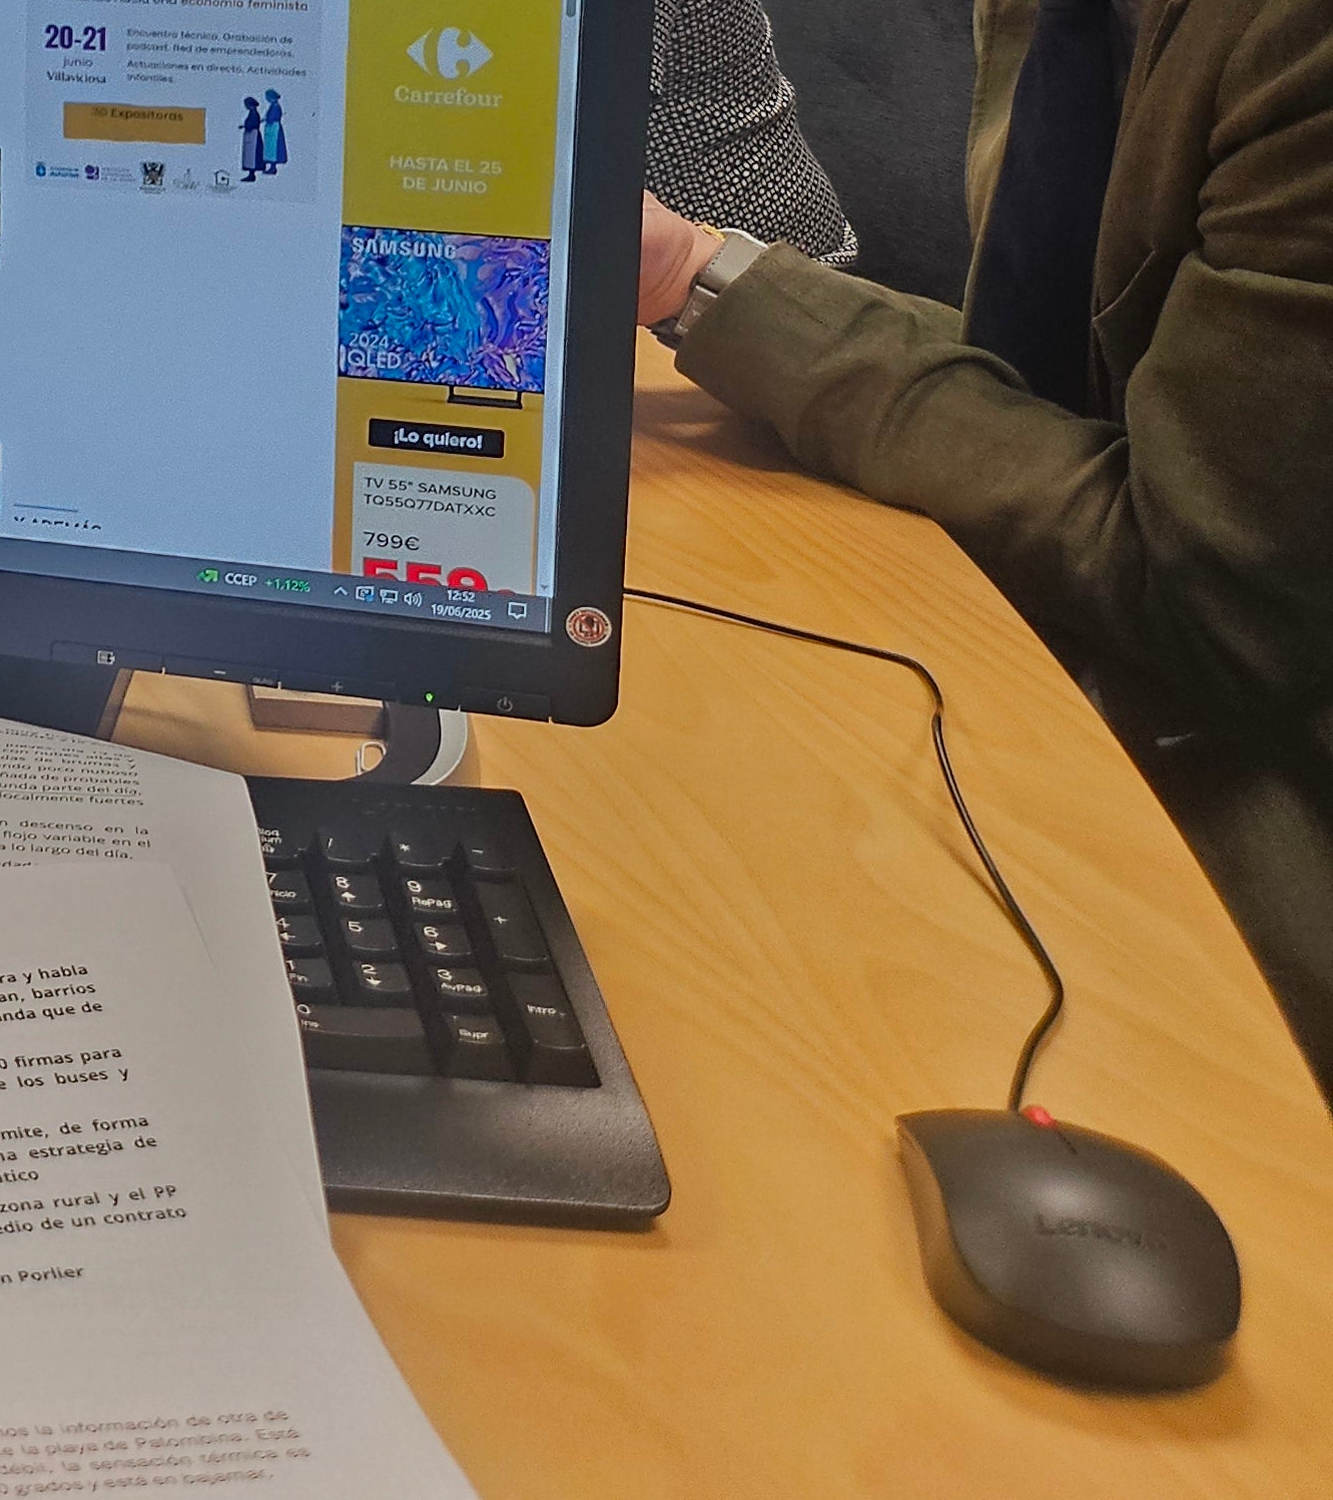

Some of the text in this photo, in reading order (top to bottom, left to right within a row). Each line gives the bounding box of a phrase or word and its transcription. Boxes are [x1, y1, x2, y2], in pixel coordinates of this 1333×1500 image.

[44, 23, 106, 51] 20-21
[393, 84, 503, 107] Carrefour
[389, 154, 502, 175] HASTA EL 25
[402, 176, 487, 194] DE JUNIO
[352, 237, 456, 259] SAMSUNG
[347, 350, 401, 369] QLED
[393, 427, 482, 449] ¡Lo quiero!
[364, 476, 496, 500] TV 55" SAMSUNG
[363, 493, 495, 517] TQ55Q77DATXXC
[363, 531, 419, 551] 799€
[447, 589, 475, 602] 12:52
[431, 603, 491, 620] 19/06/2025
[22, 972, 32, 984] y
[37, 964, 88, 979] habla
